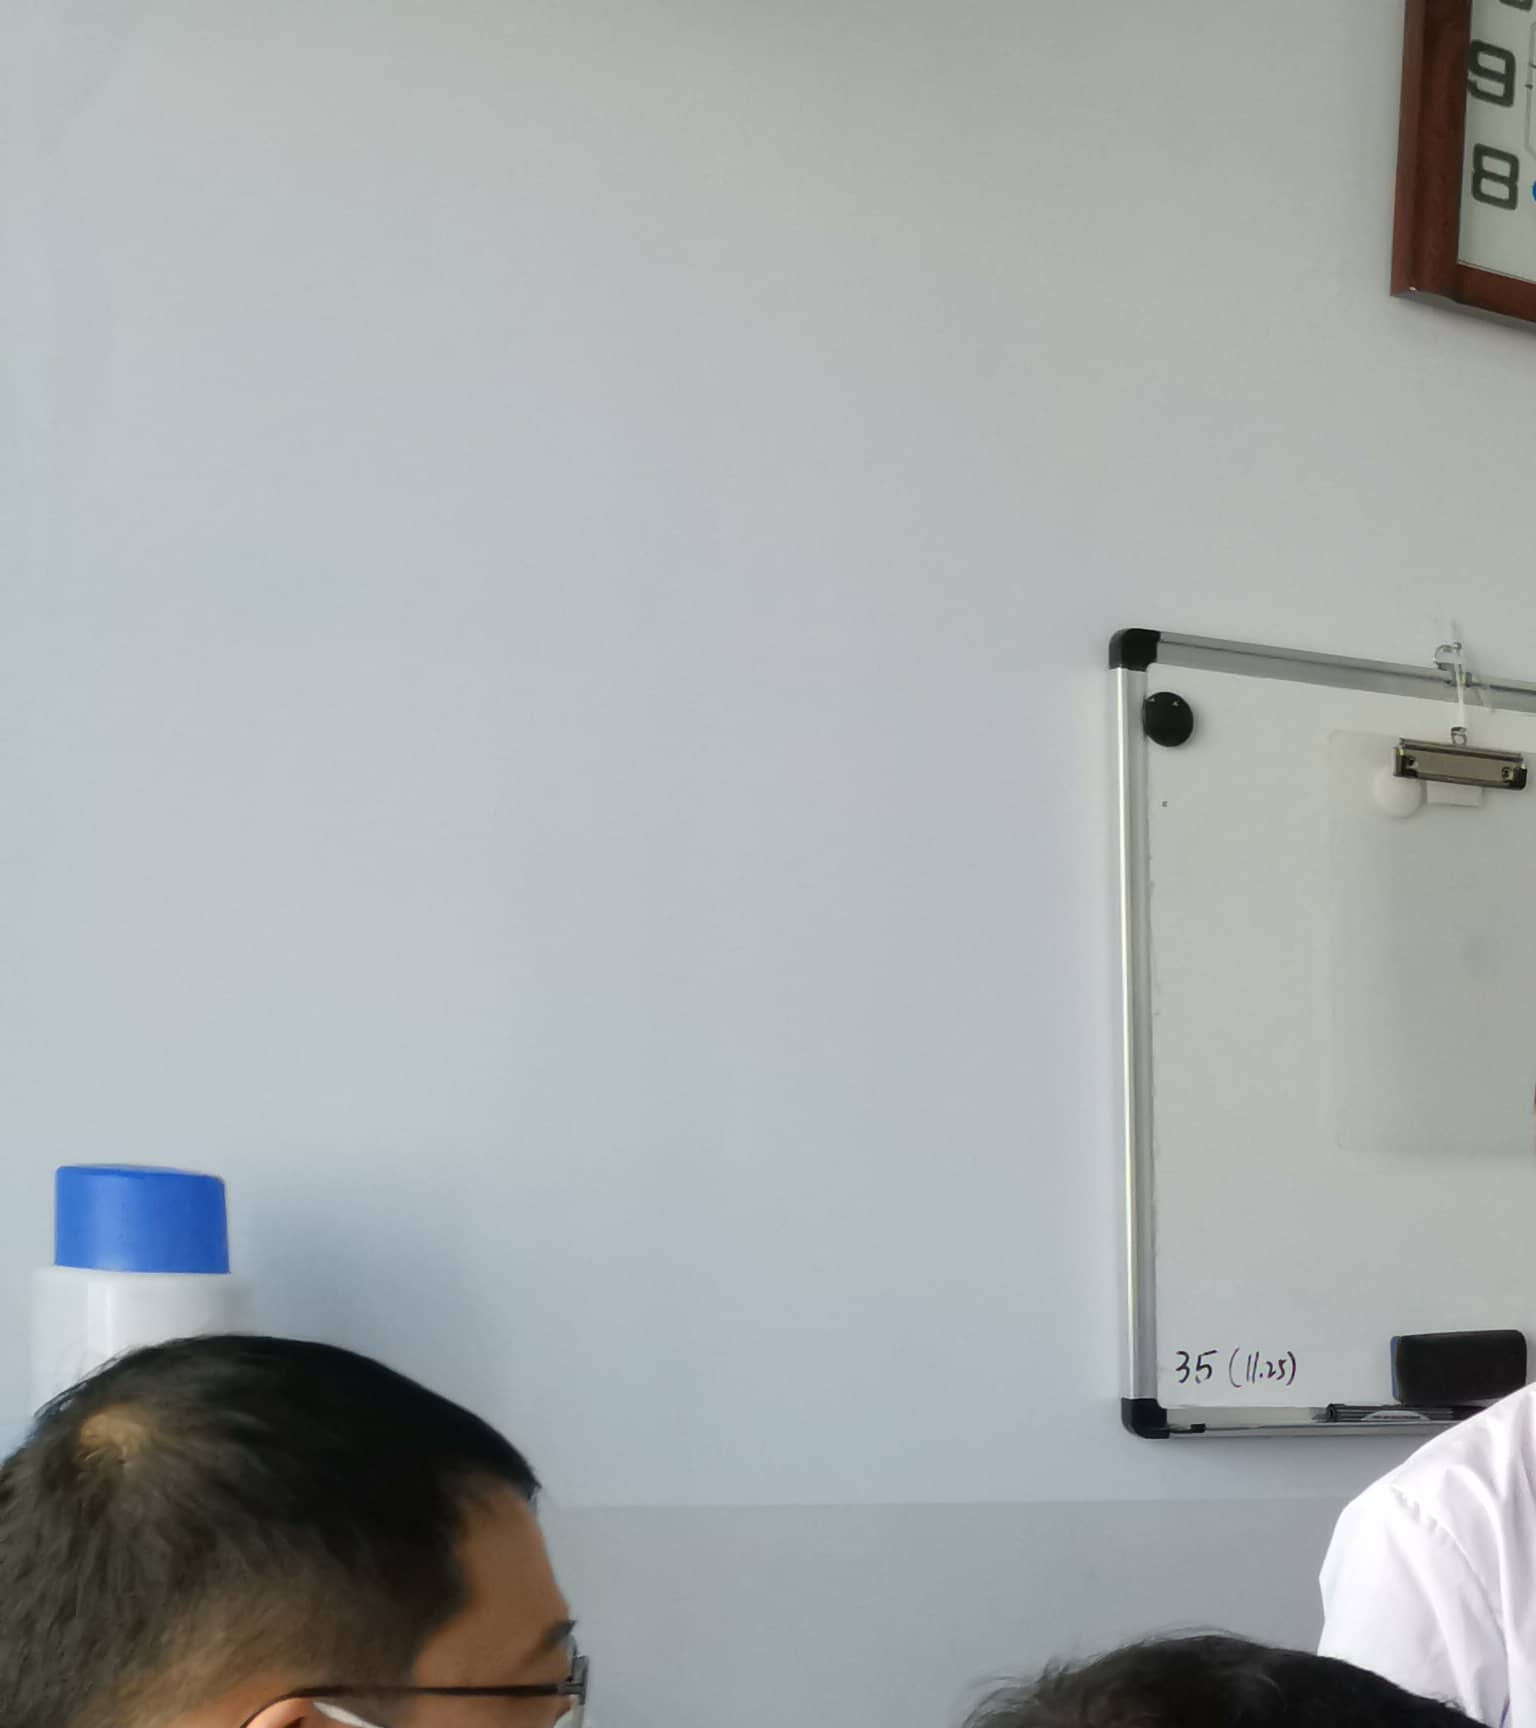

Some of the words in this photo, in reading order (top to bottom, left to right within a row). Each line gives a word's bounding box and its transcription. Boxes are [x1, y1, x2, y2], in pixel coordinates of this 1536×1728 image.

[1467, 39, 1516, 108] 9
[1471, 143, 1519, 210] 8
[1175, 1350, 1218, 1384] 35
